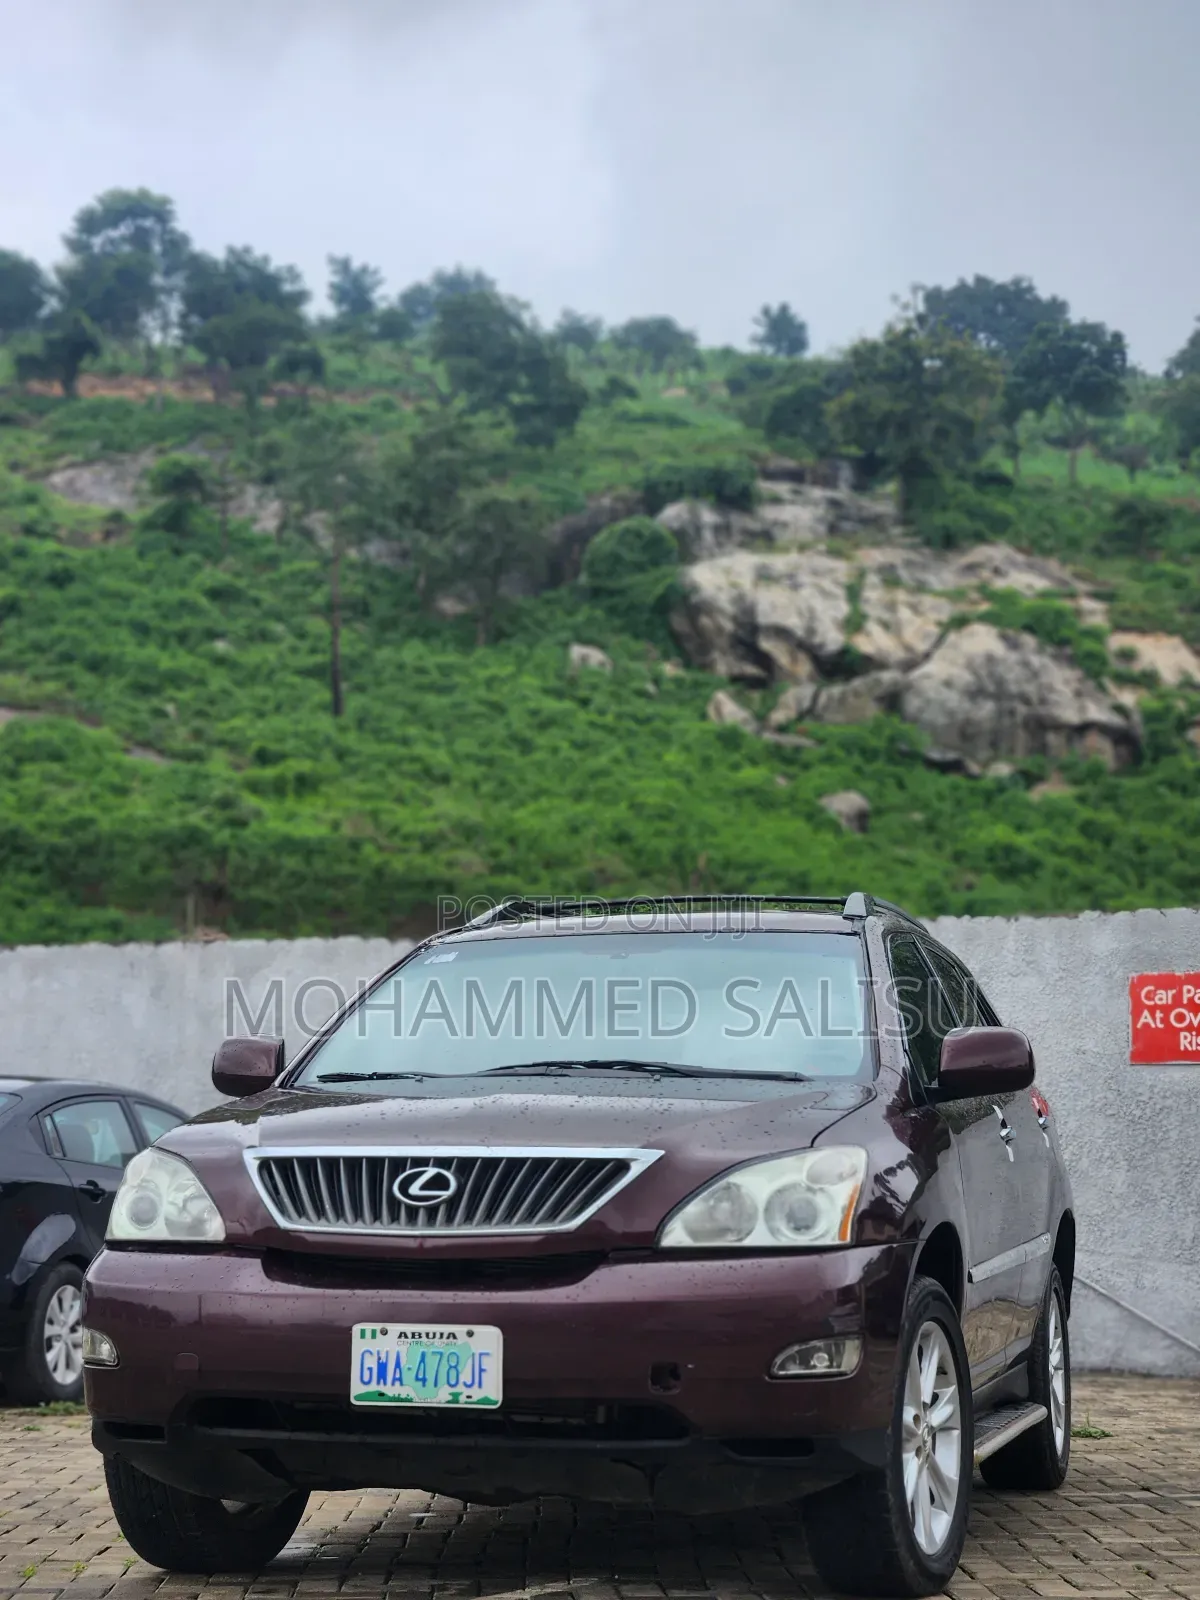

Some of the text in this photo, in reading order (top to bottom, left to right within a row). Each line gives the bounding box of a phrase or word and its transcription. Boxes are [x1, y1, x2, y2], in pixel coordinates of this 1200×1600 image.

[1141, 985, 1177, 1006] Car
[1136, 1008, 1164, 1029] At
[397, 1331, 458, 1340] ABUJA
[360, 1349, 491, 1389] GWA-478JF
